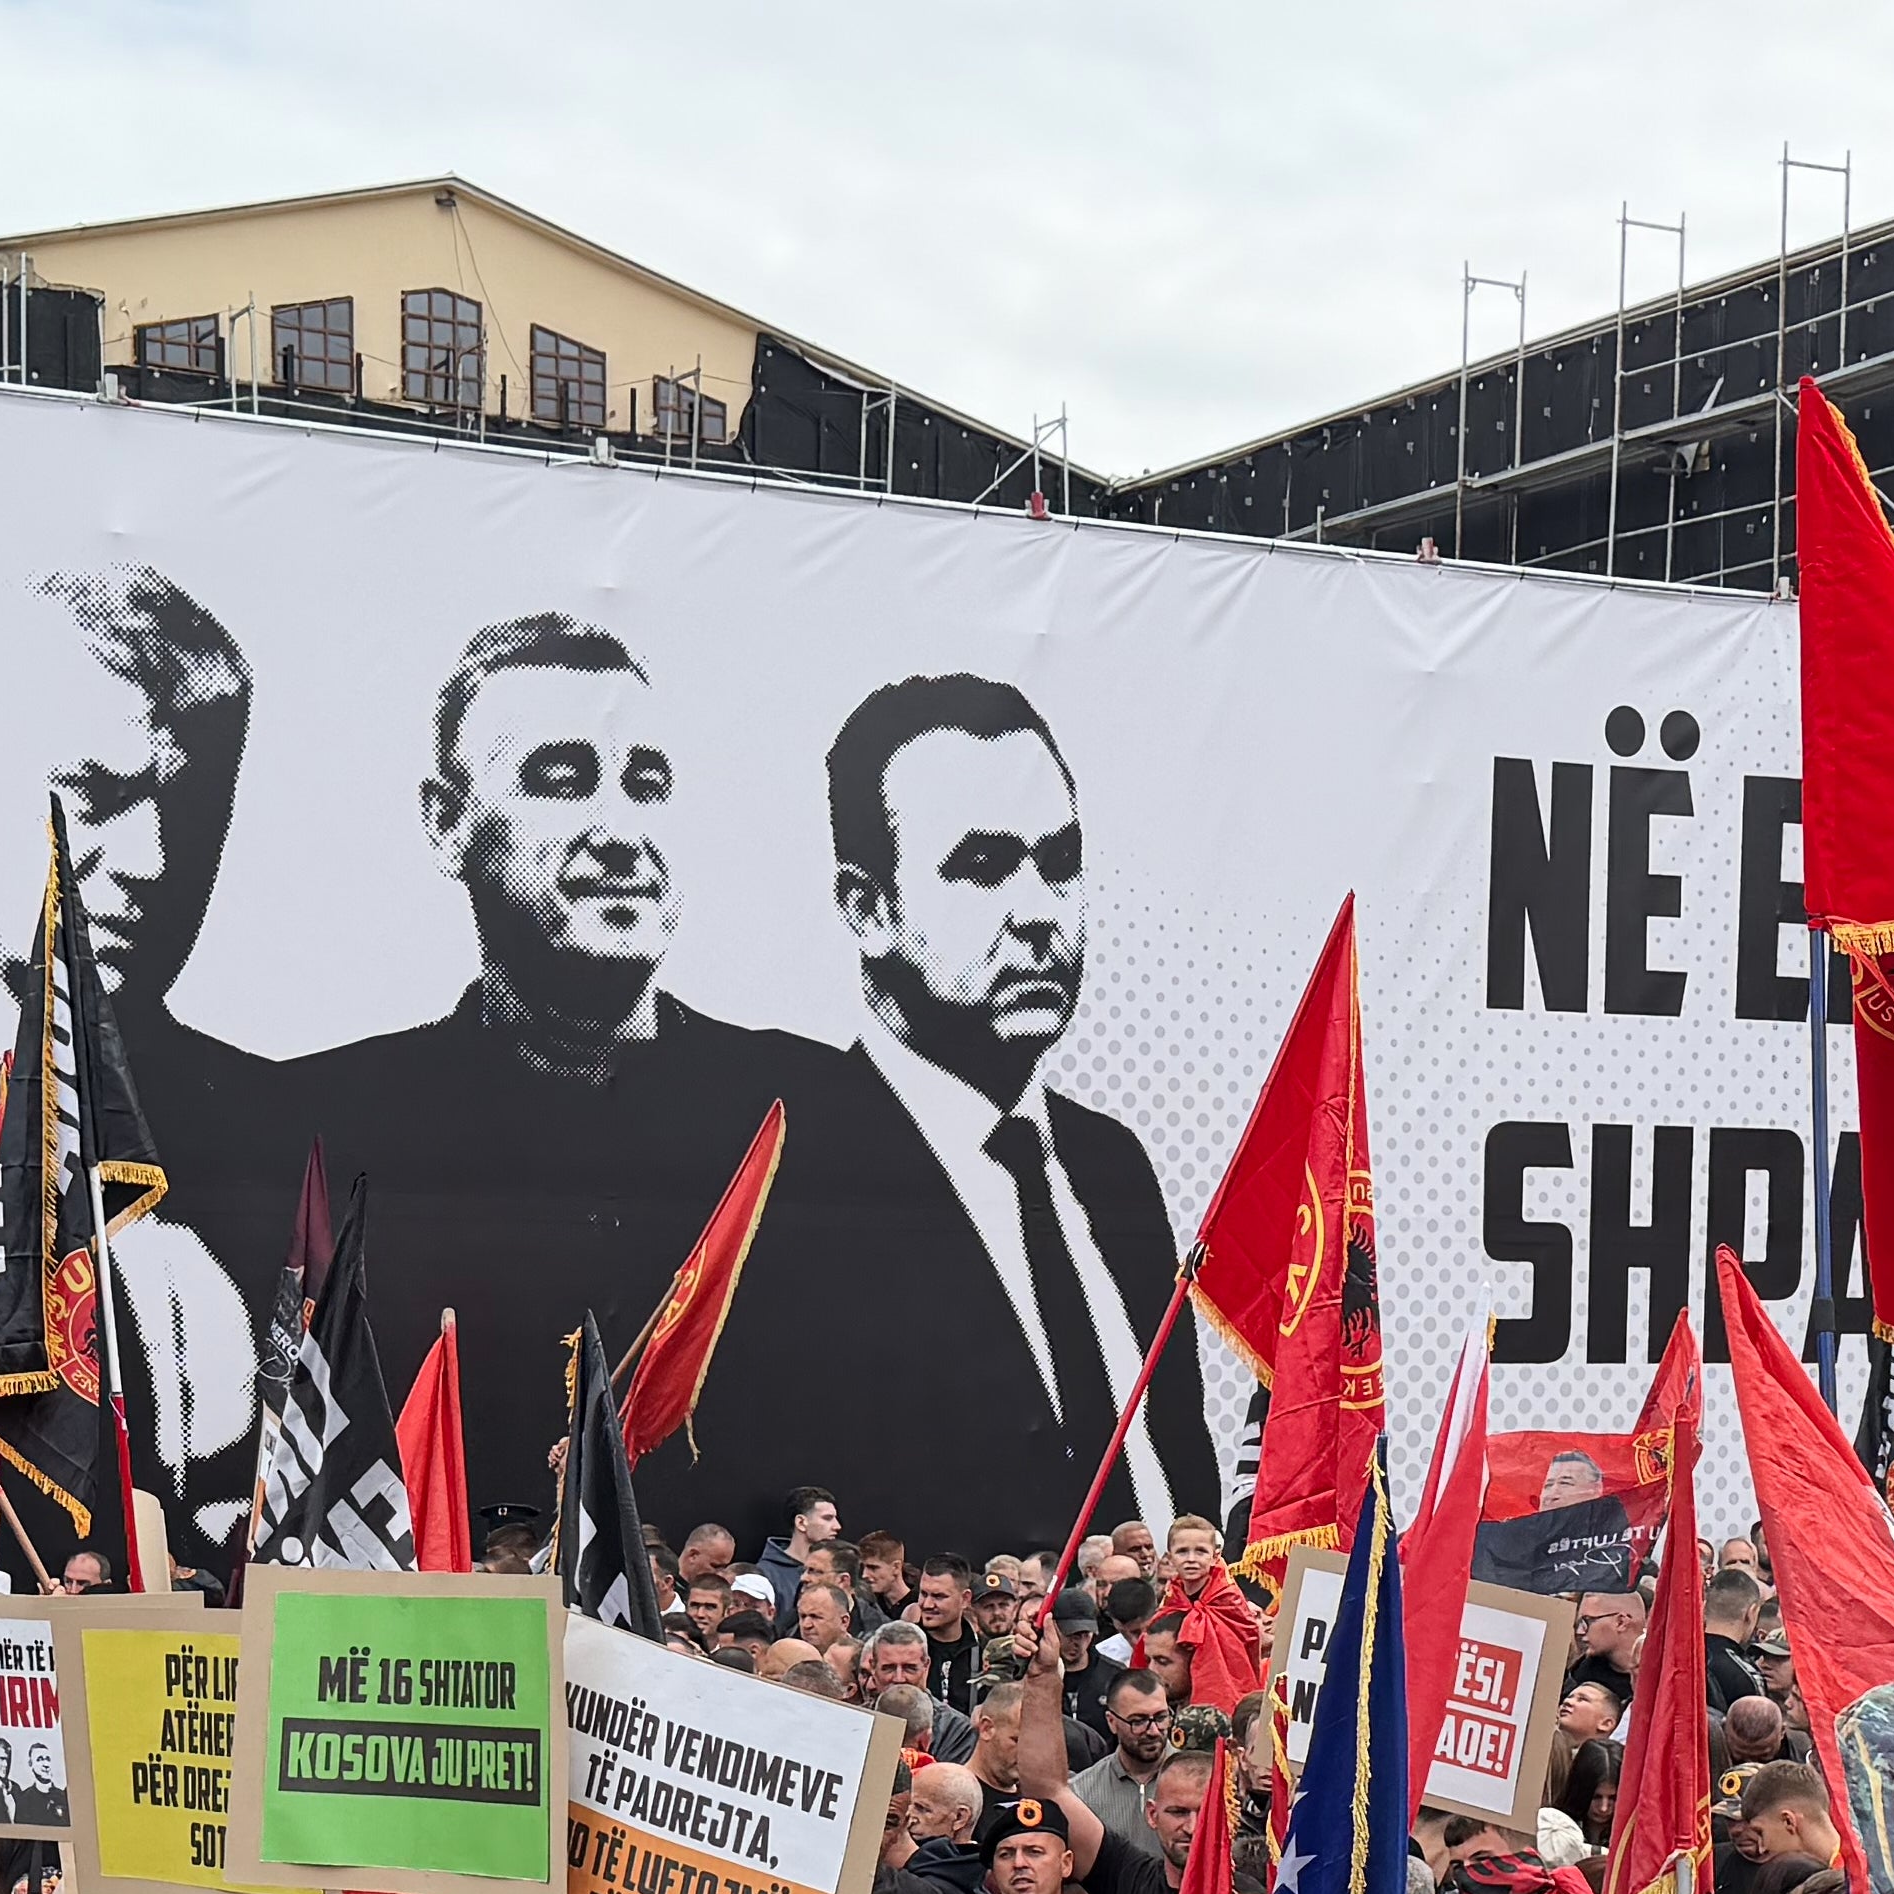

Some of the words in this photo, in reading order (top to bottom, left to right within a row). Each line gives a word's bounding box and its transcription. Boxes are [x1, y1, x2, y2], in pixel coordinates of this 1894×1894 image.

[1485, 704, 1700, 1017] NË
[26, 1640, 46, 1672] TË
[165, 1644, 208, 1699] PËR
[318, 1646, 371, 1703] MË
[377, 1658, 412, 1705] 16
[419, 1659, 516, 1710] SHTATOR
[131, 1753, 179, 1808] PËR
[287, 1731, 426, 1784] KOSOVA
[431, 1737, 462, 1787] JU
[466, 1739, 533, 1792] PRET!
[663, 1720, 844, 1821] VENDIMEVE
[584, 1748, 619, 1806] TË
[613, 1766, 779, 1870] PADREJTA,
[567, 1817, 590, 1869] O
[591, 1825, 627, 1883] TË
